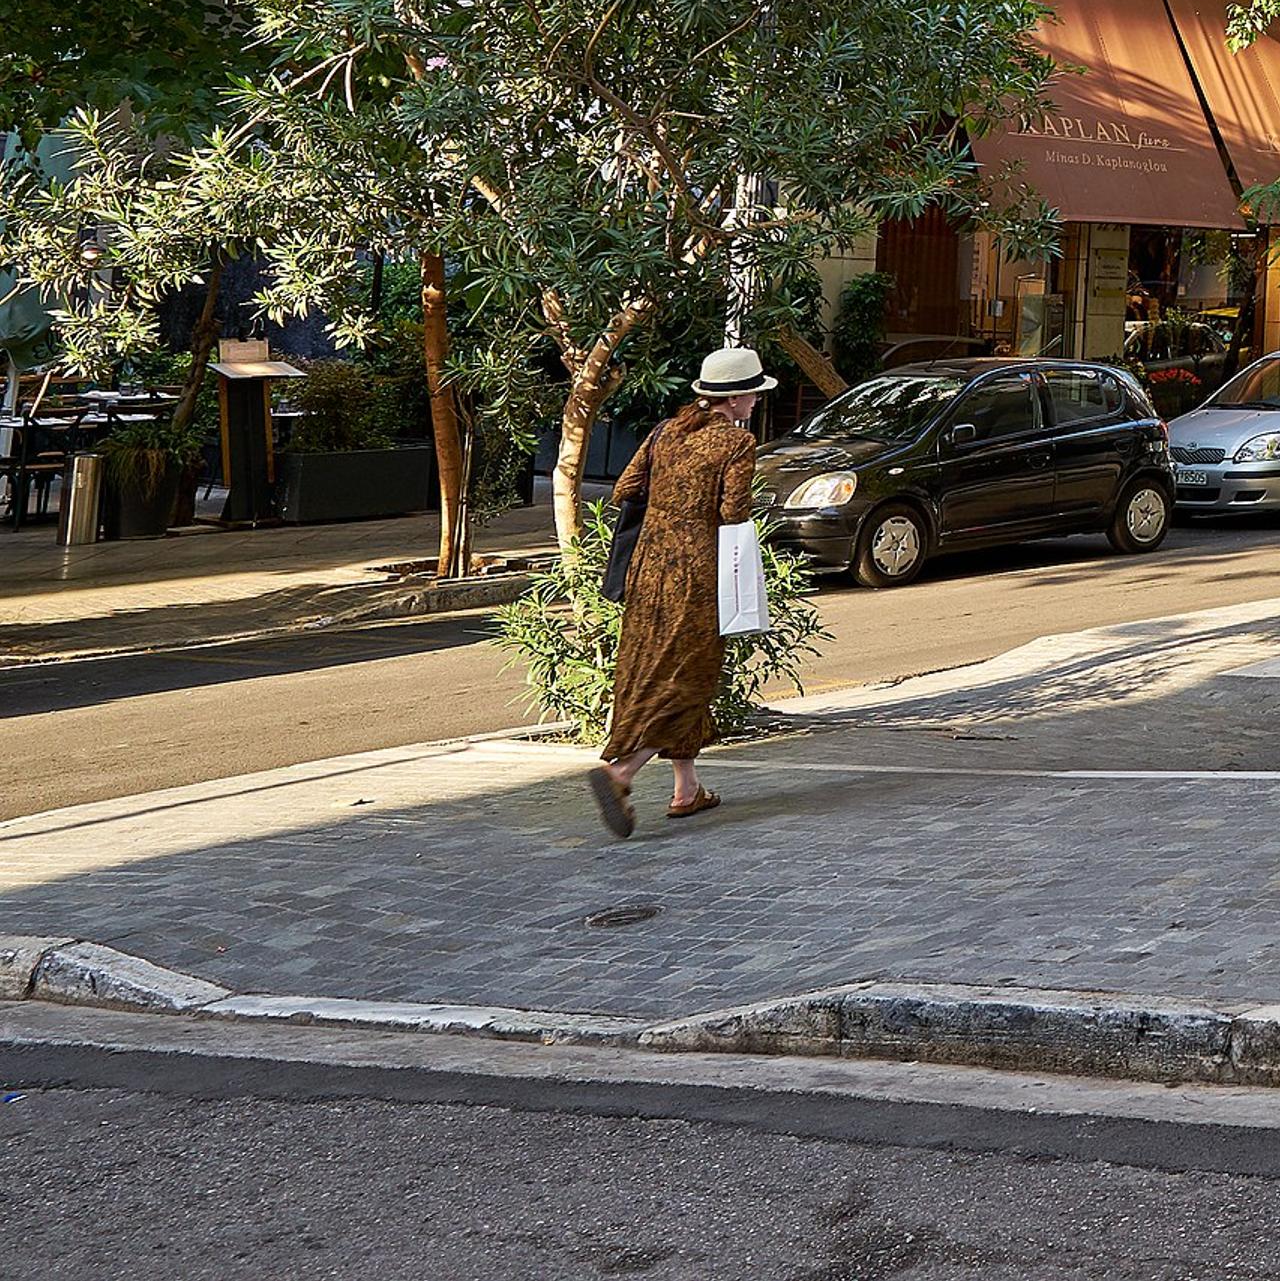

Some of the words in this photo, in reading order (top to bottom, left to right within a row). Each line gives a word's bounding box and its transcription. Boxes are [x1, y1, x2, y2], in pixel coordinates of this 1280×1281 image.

[1133, 132, 1171, 149] furs
[1046, 150, 1079, 164] Minas
[1082, 153, 1095, 165] D.
[1096, 154, 1168, 174] Kaplanoglou
